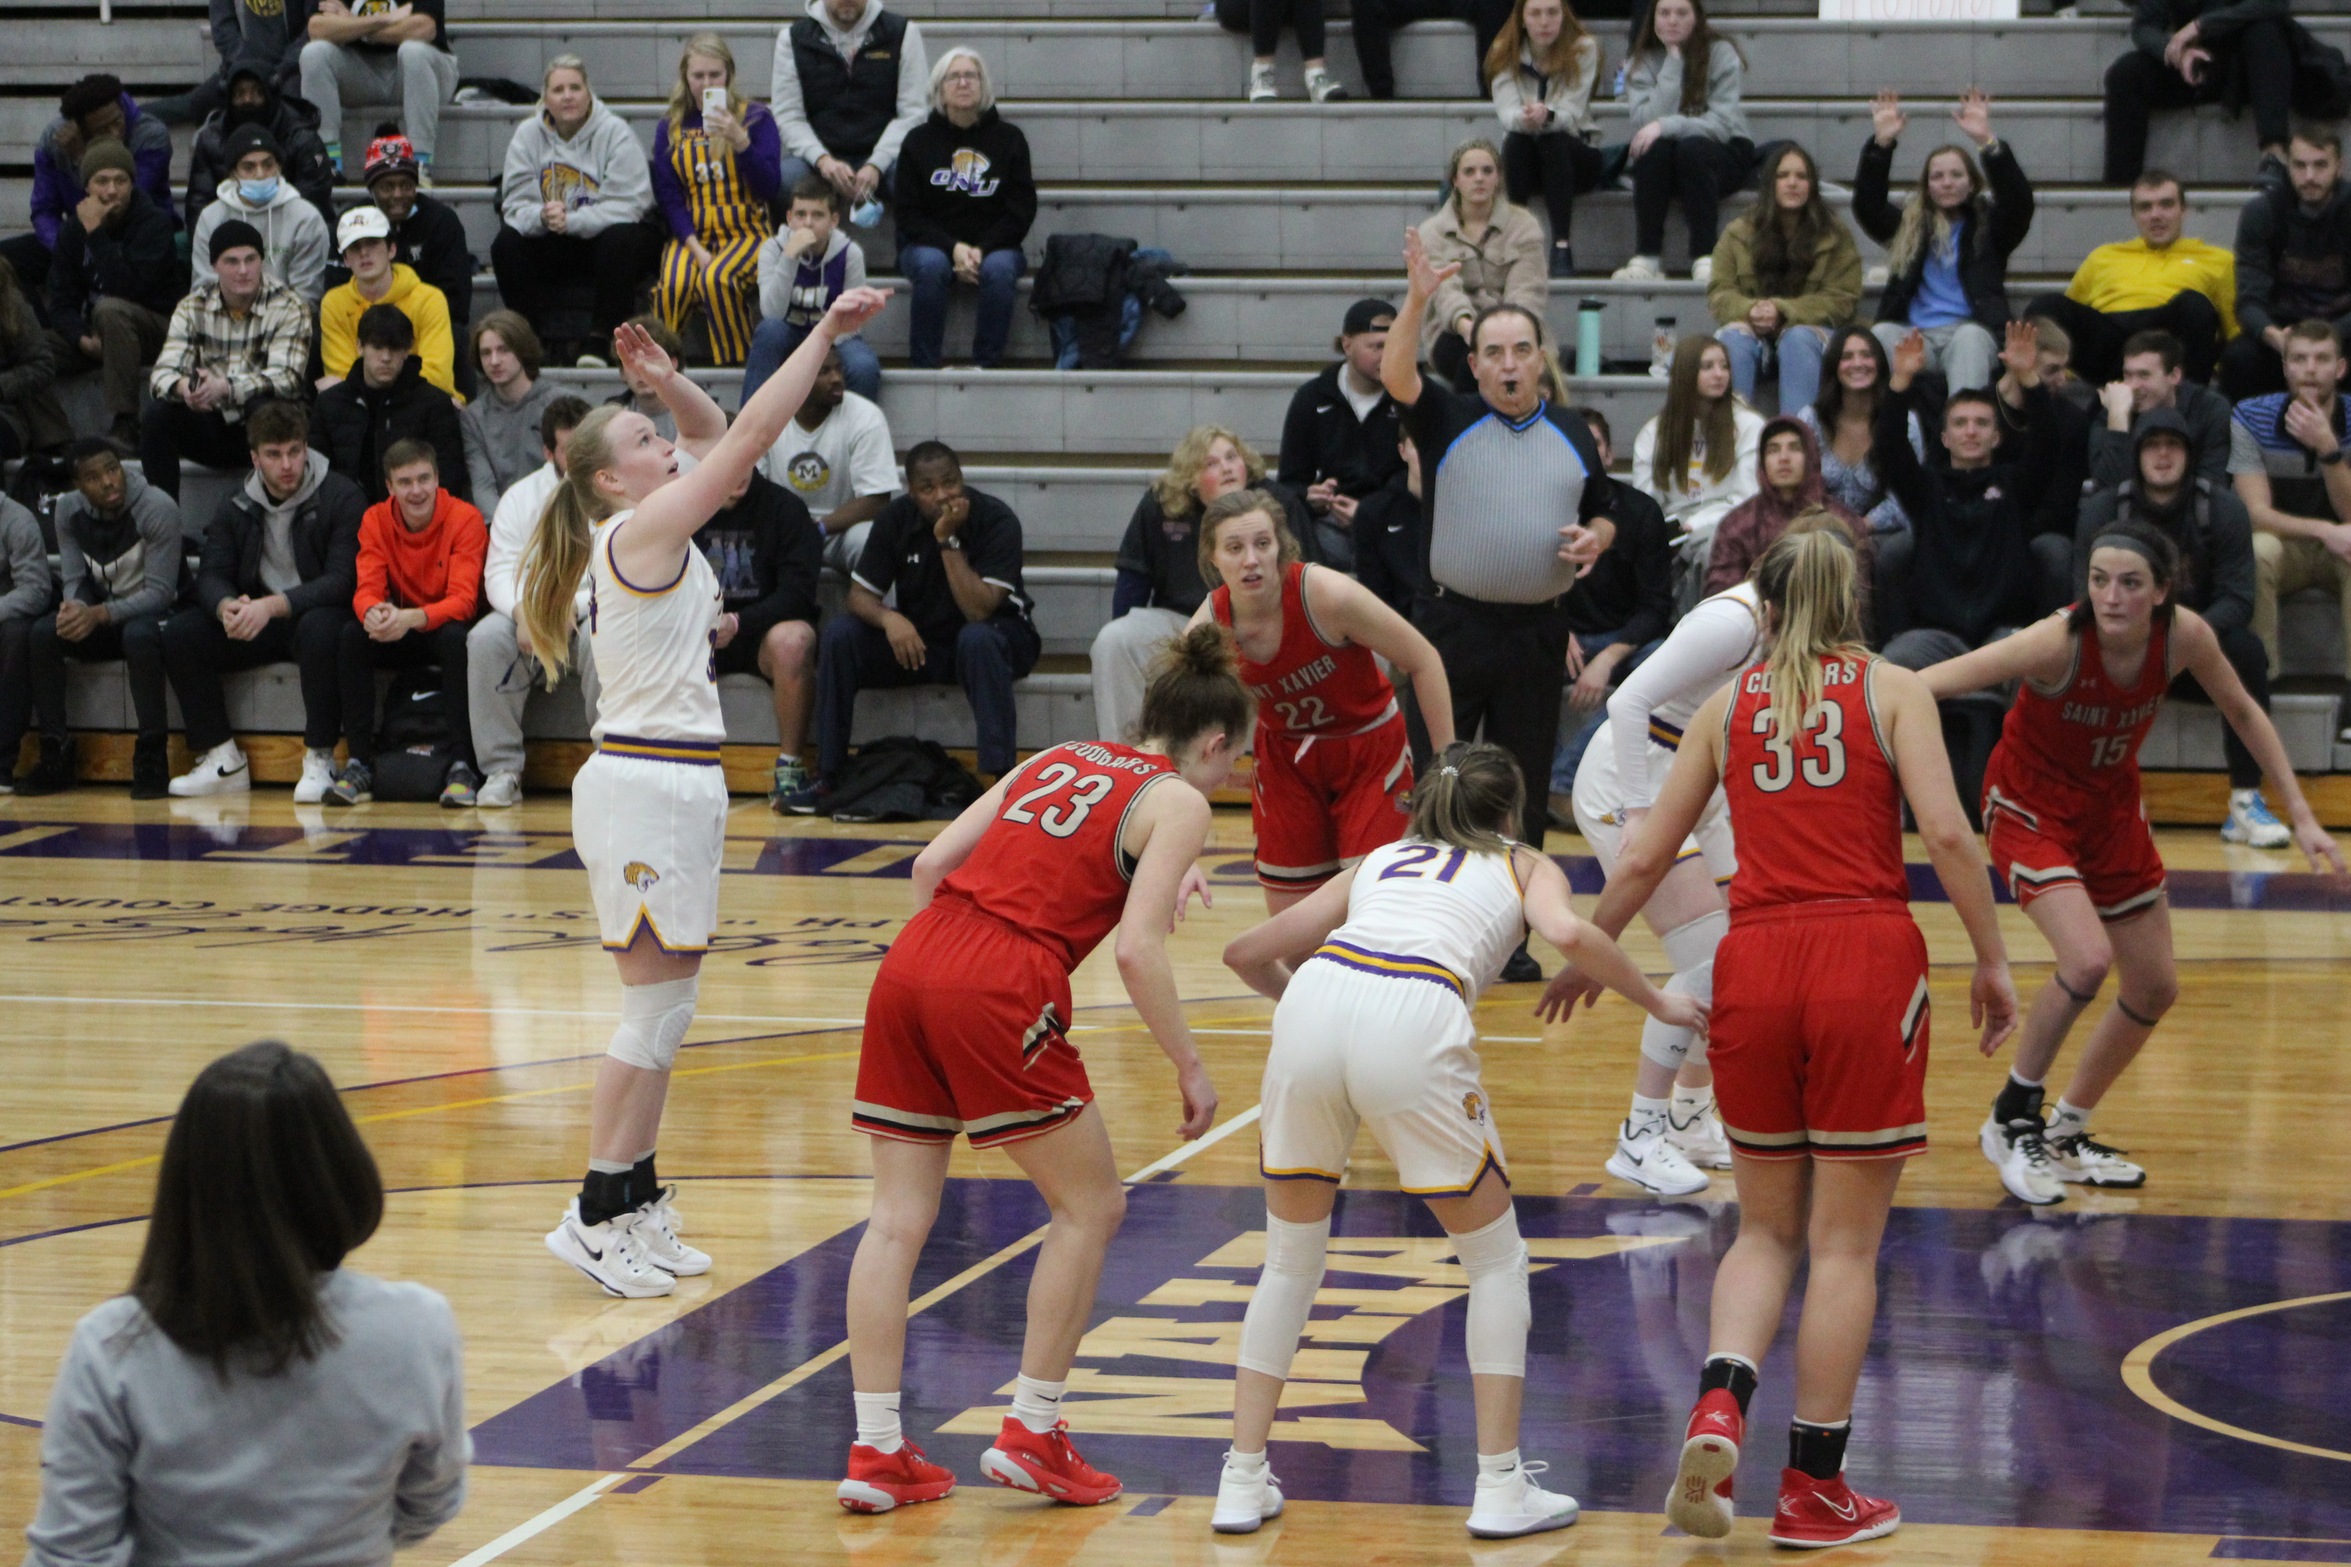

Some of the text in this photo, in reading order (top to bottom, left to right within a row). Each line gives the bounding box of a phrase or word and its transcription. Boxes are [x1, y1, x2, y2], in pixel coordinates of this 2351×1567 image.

[695, 160, 724, 183] 33
[930, 168, 1000, 197] ONU
[1278, 654, 1337, 695] XAVIER
[1745, 660, 1858, 695] CORS
[1274, 696, 1336, 730] 22
[2062, 701, 2110, 728] SAINT
[1064, 740, 1158, 776] COUGARS
[1751, 699, 1847, 793] 33
[2090, 733, 2132, 769] 15
[1002, 762, 1115, 839] 23
[1376, 844, 1469, 885] 21
[238, 901, 476, 919] HODGE
